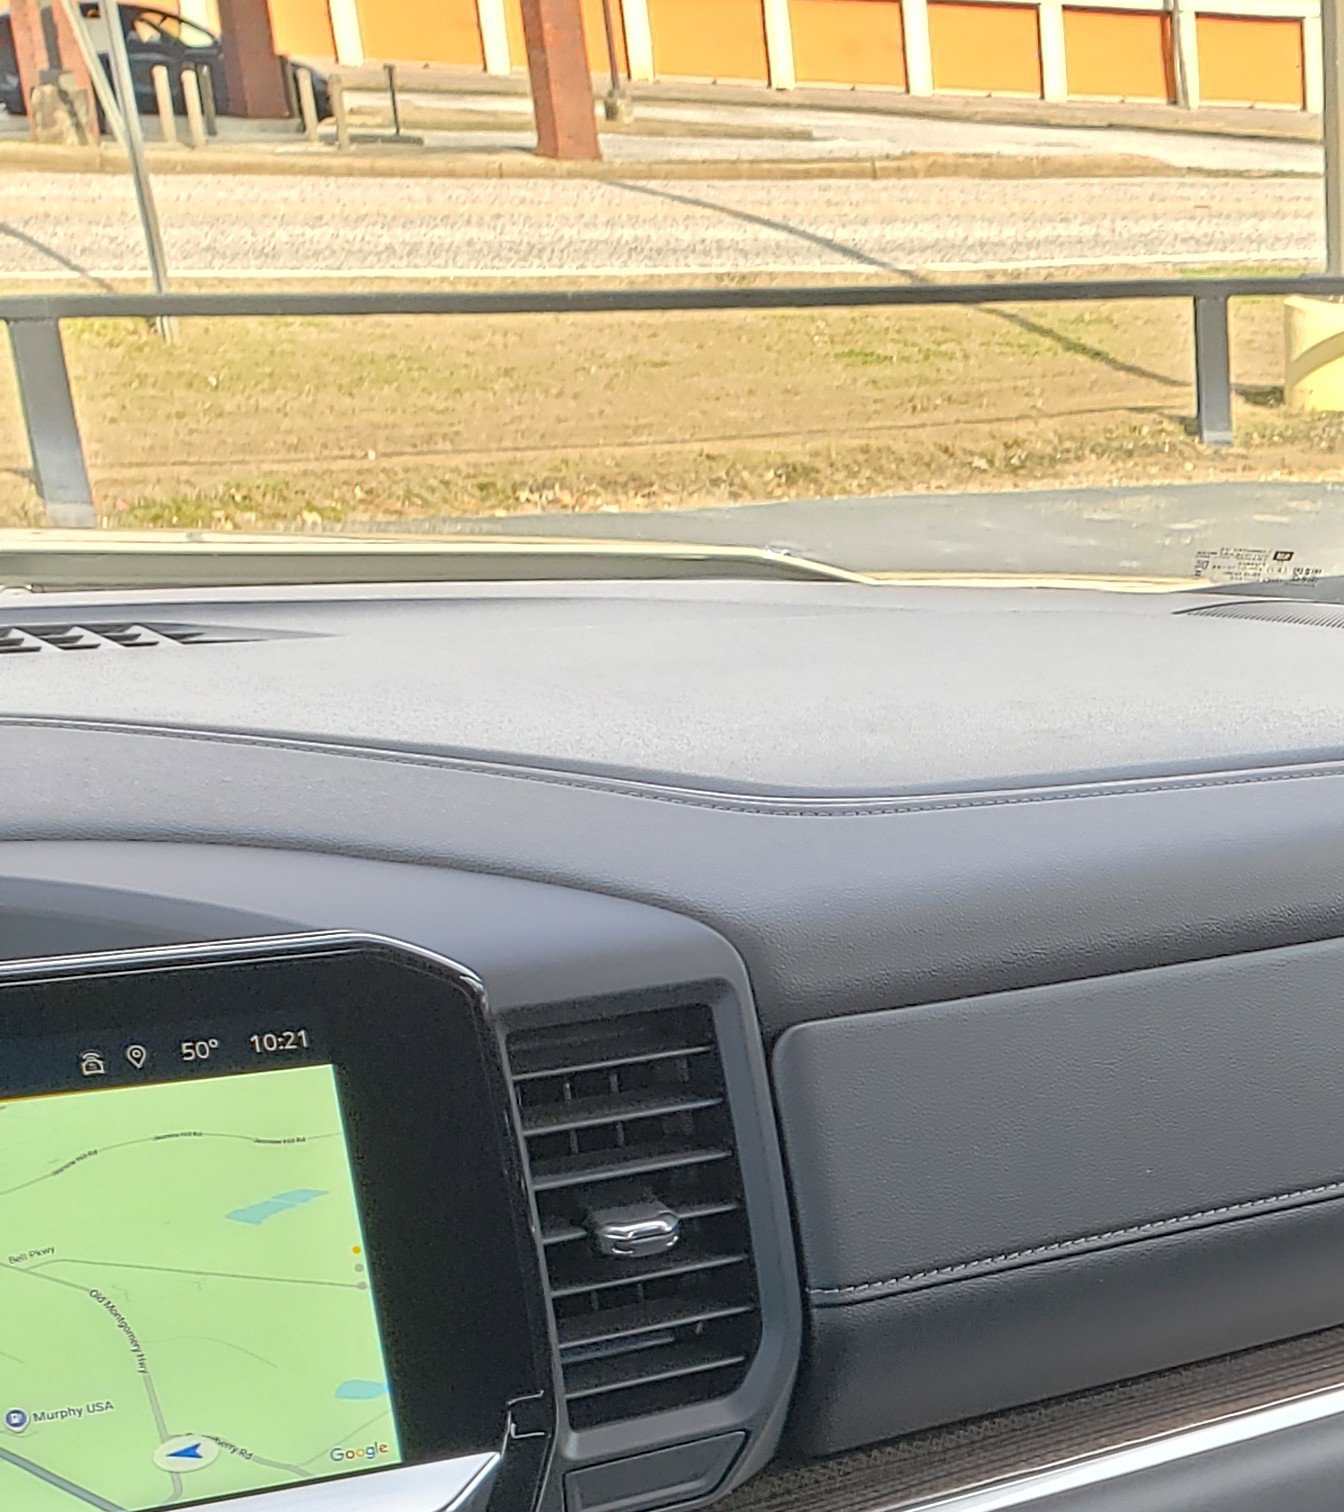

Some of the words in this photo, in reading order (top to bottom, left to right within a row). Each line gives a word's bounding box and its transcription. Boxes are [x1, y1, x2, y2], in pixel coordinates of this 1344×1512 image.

[181, 1039, 219, 1061] 50°
[250, 1030, 309, 1054] 10:21
[90, 1289, 106, 1303] Old
[103, 1300, 141, 1352] Montgomery
[33, 1407, 83, 1421] Murphy
[86, 1401, 114, 1413] USA
[330, 1441, 388, 1461] Google
